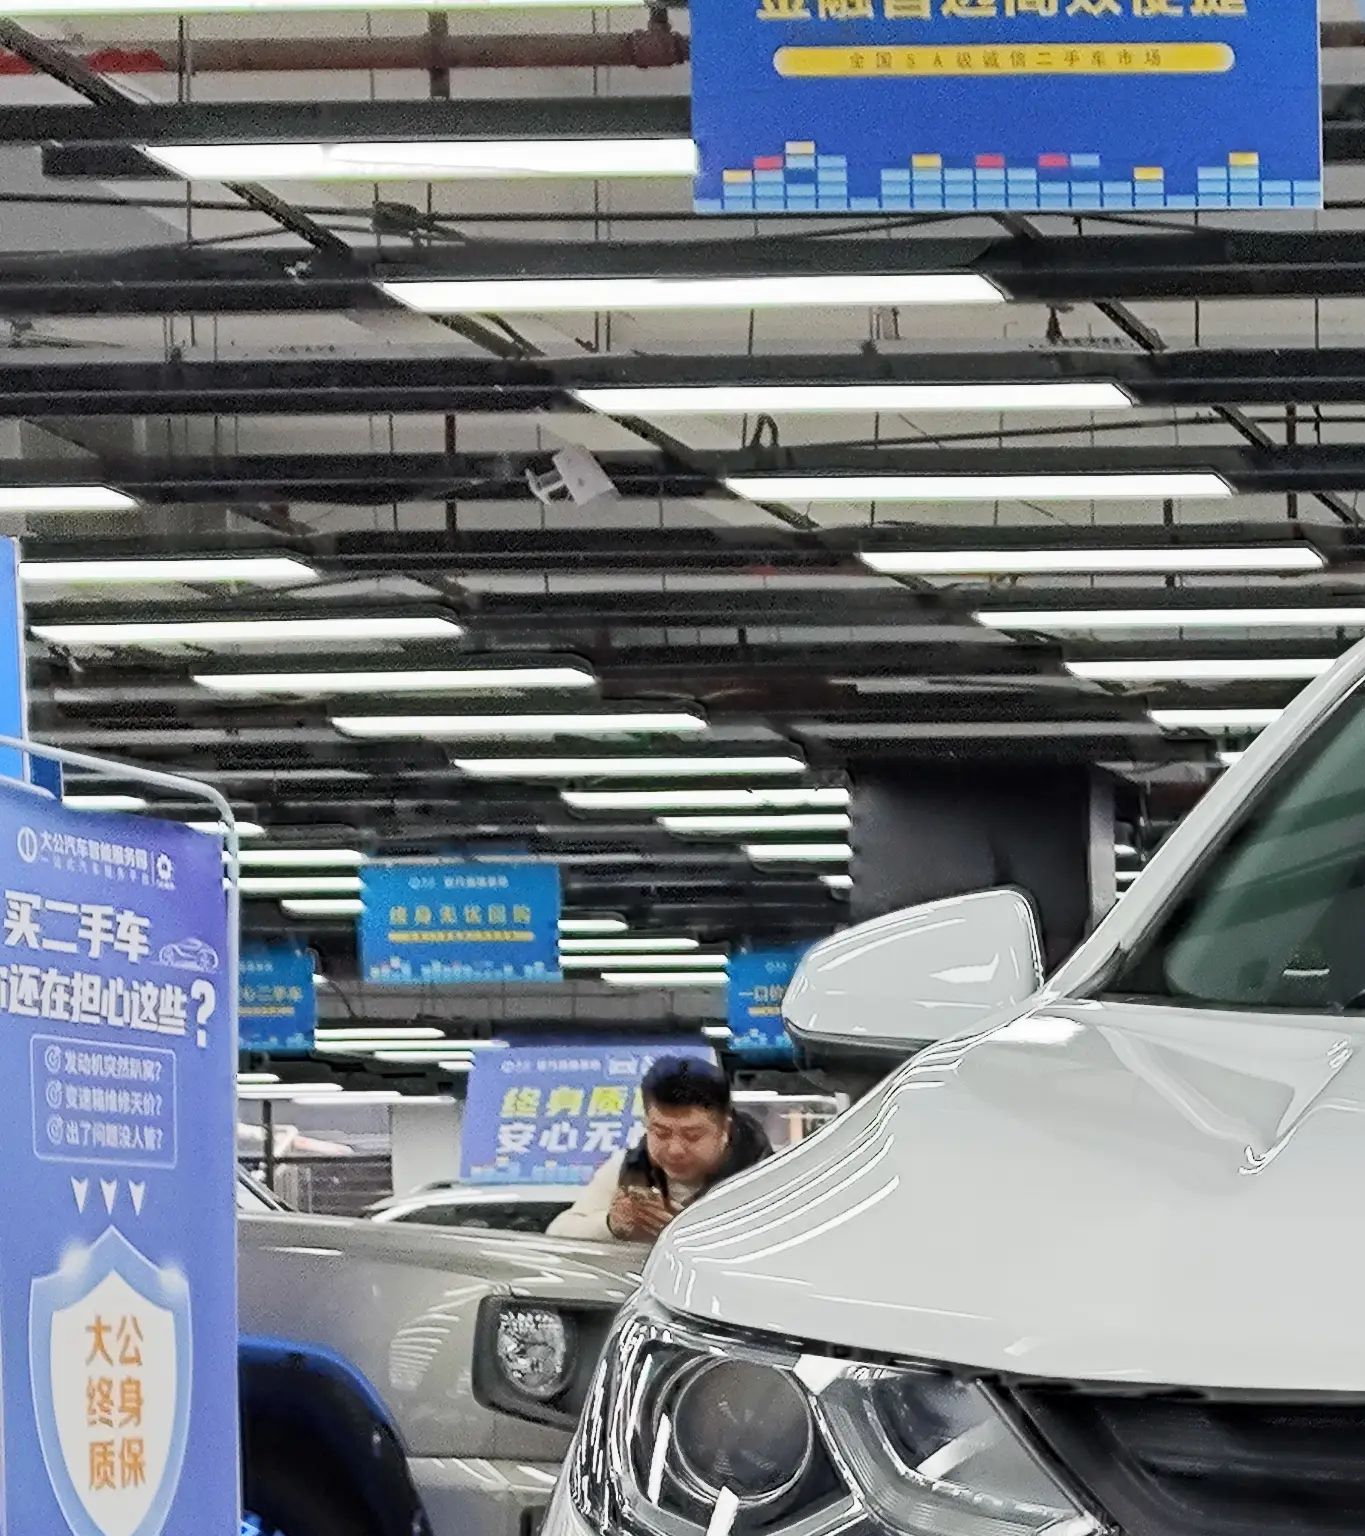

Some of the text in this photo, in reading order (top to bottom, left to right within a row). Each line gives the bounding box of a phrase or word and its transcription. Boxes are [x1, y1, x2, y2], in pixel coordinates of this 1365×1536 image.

[4, 889, 151, 964] 买二手车
[85, 1314, 144, 1367] 大公
[85, 1375, 144, 1429] 终身
[88, 1437, 146, 1491] 质保
